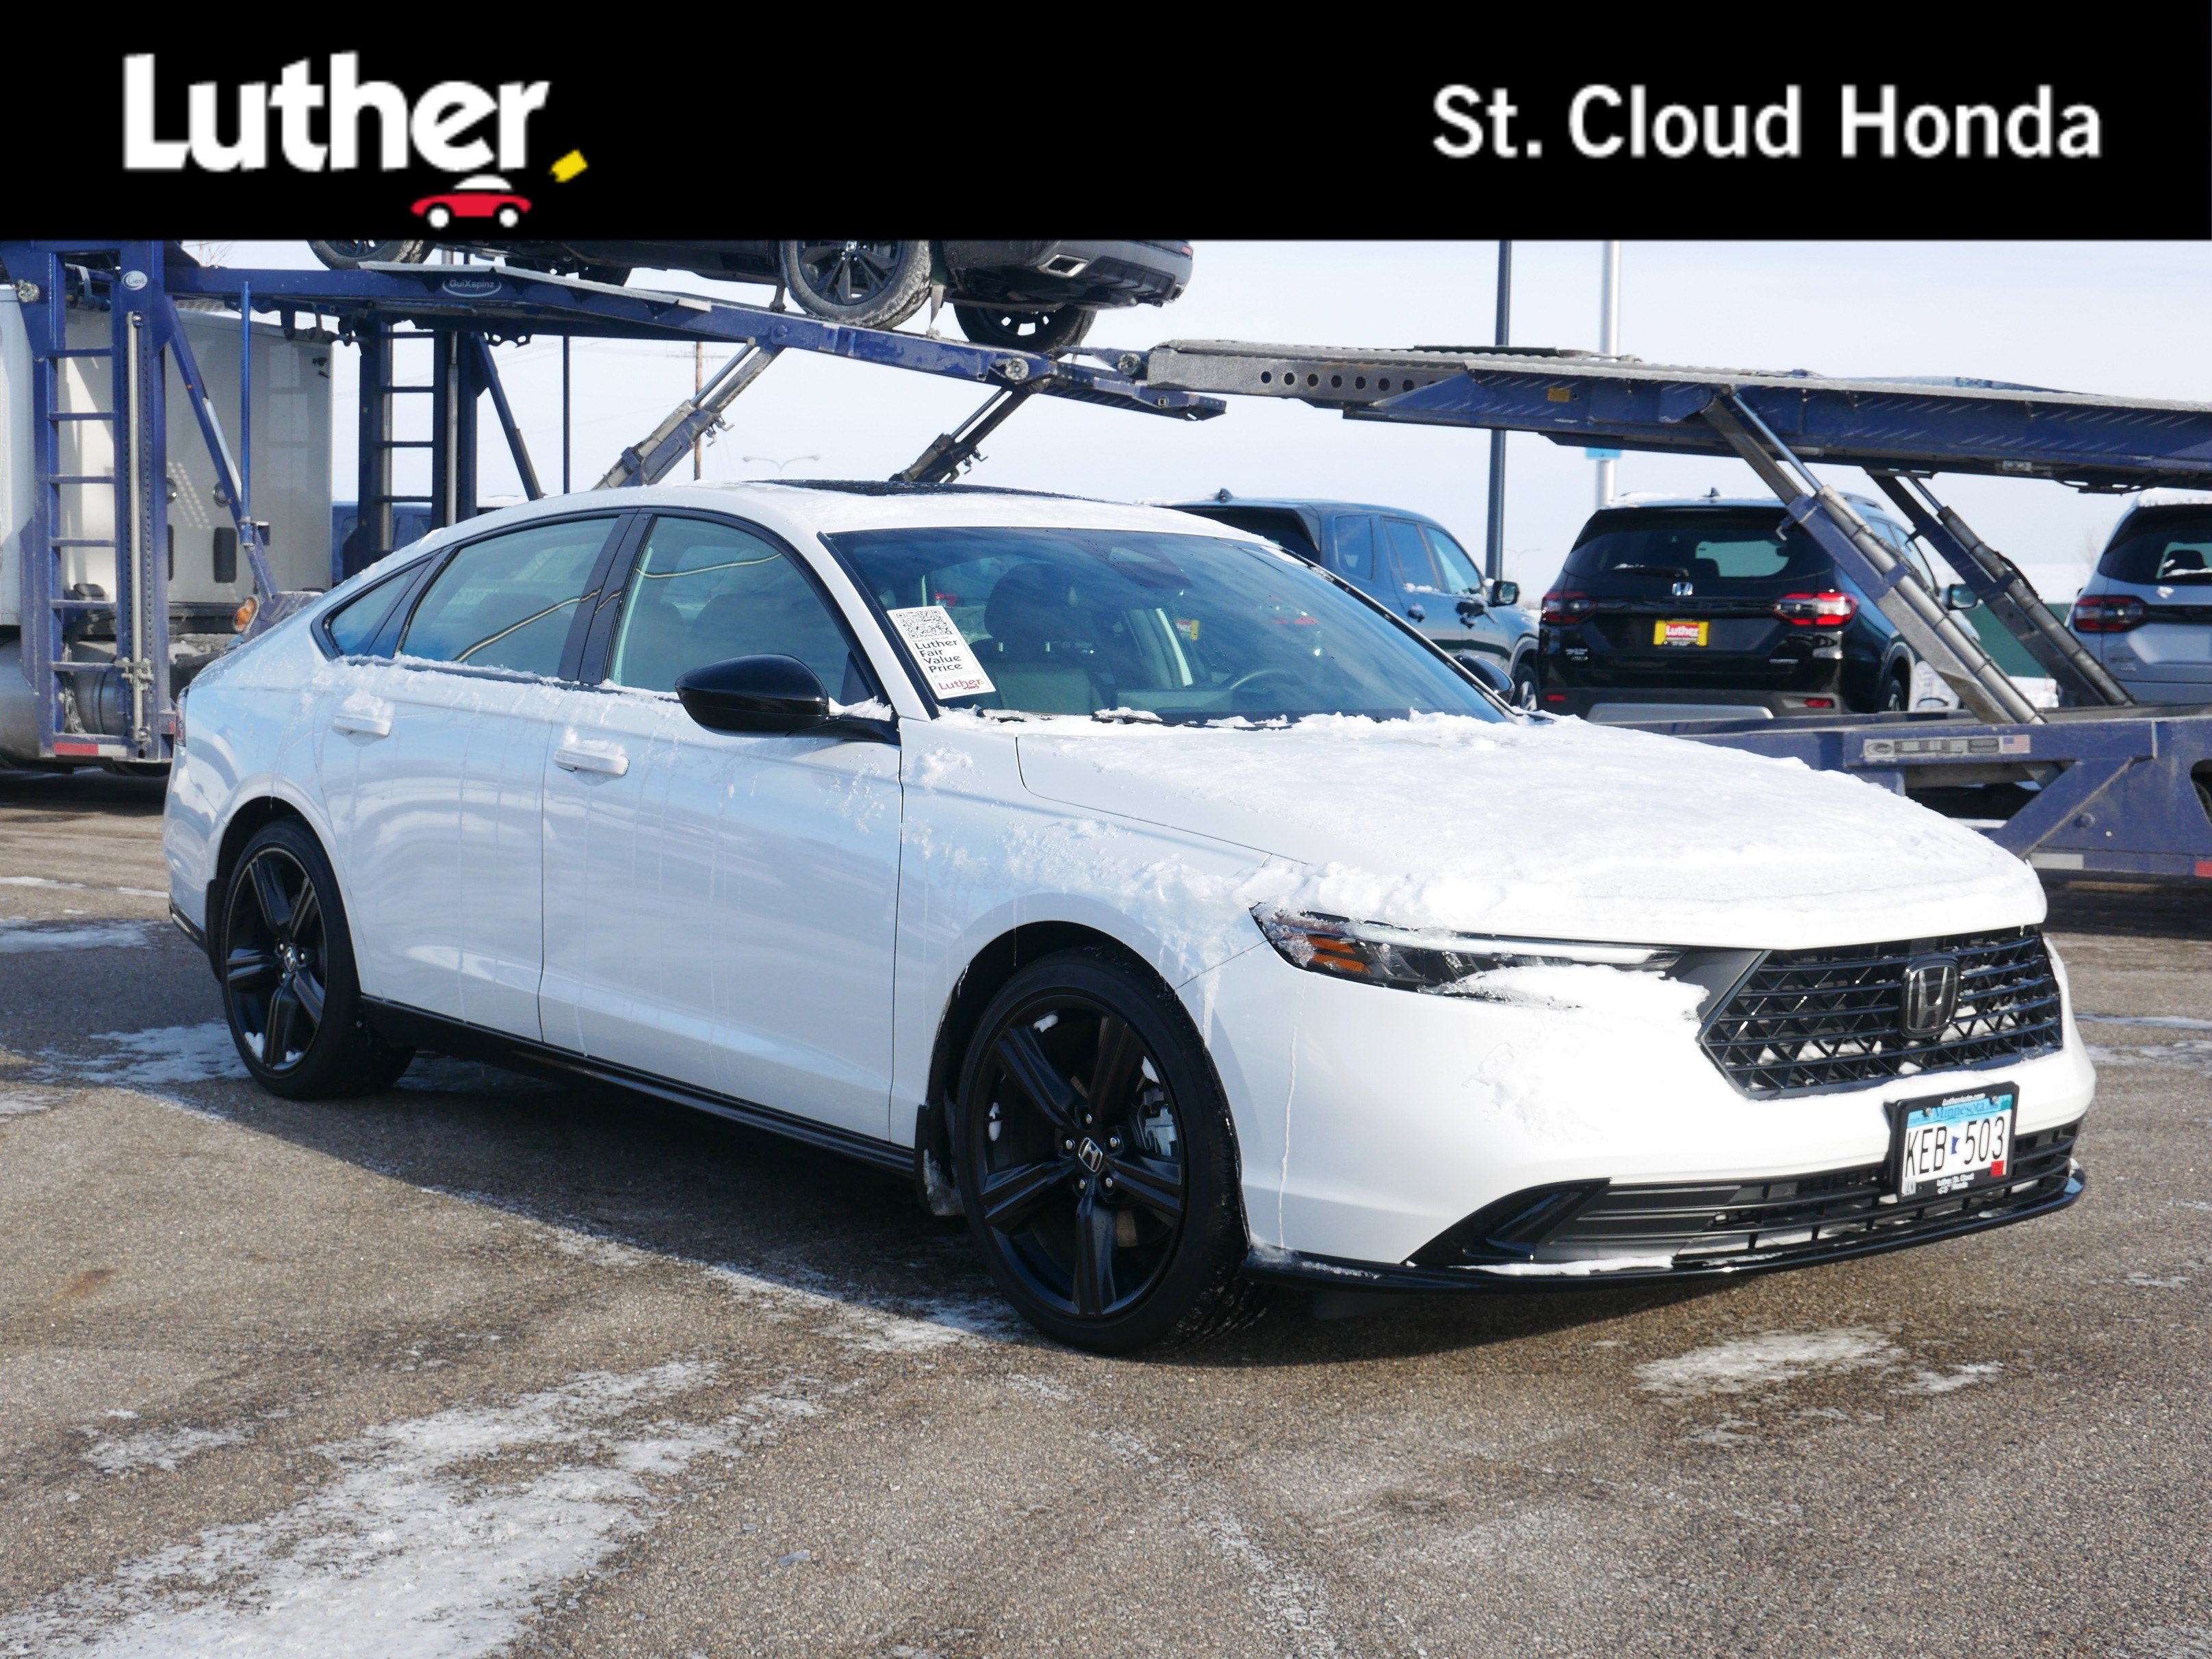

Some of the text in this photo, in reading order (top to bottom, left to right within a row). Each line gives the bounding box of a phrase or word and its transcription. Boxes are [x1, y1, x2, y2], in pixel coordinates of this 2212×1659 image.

[1666, 625, 1699, 637] Luther
[914, 640, 957, 650] Luther
[919, 649, 943, 658] Fair
[923, 656, 962, 665] Value
[928, 664, 963, 673] Price
[938, 679, 981, 690] Luther
[1905, 1116, 2005, 1178] KEB 503
